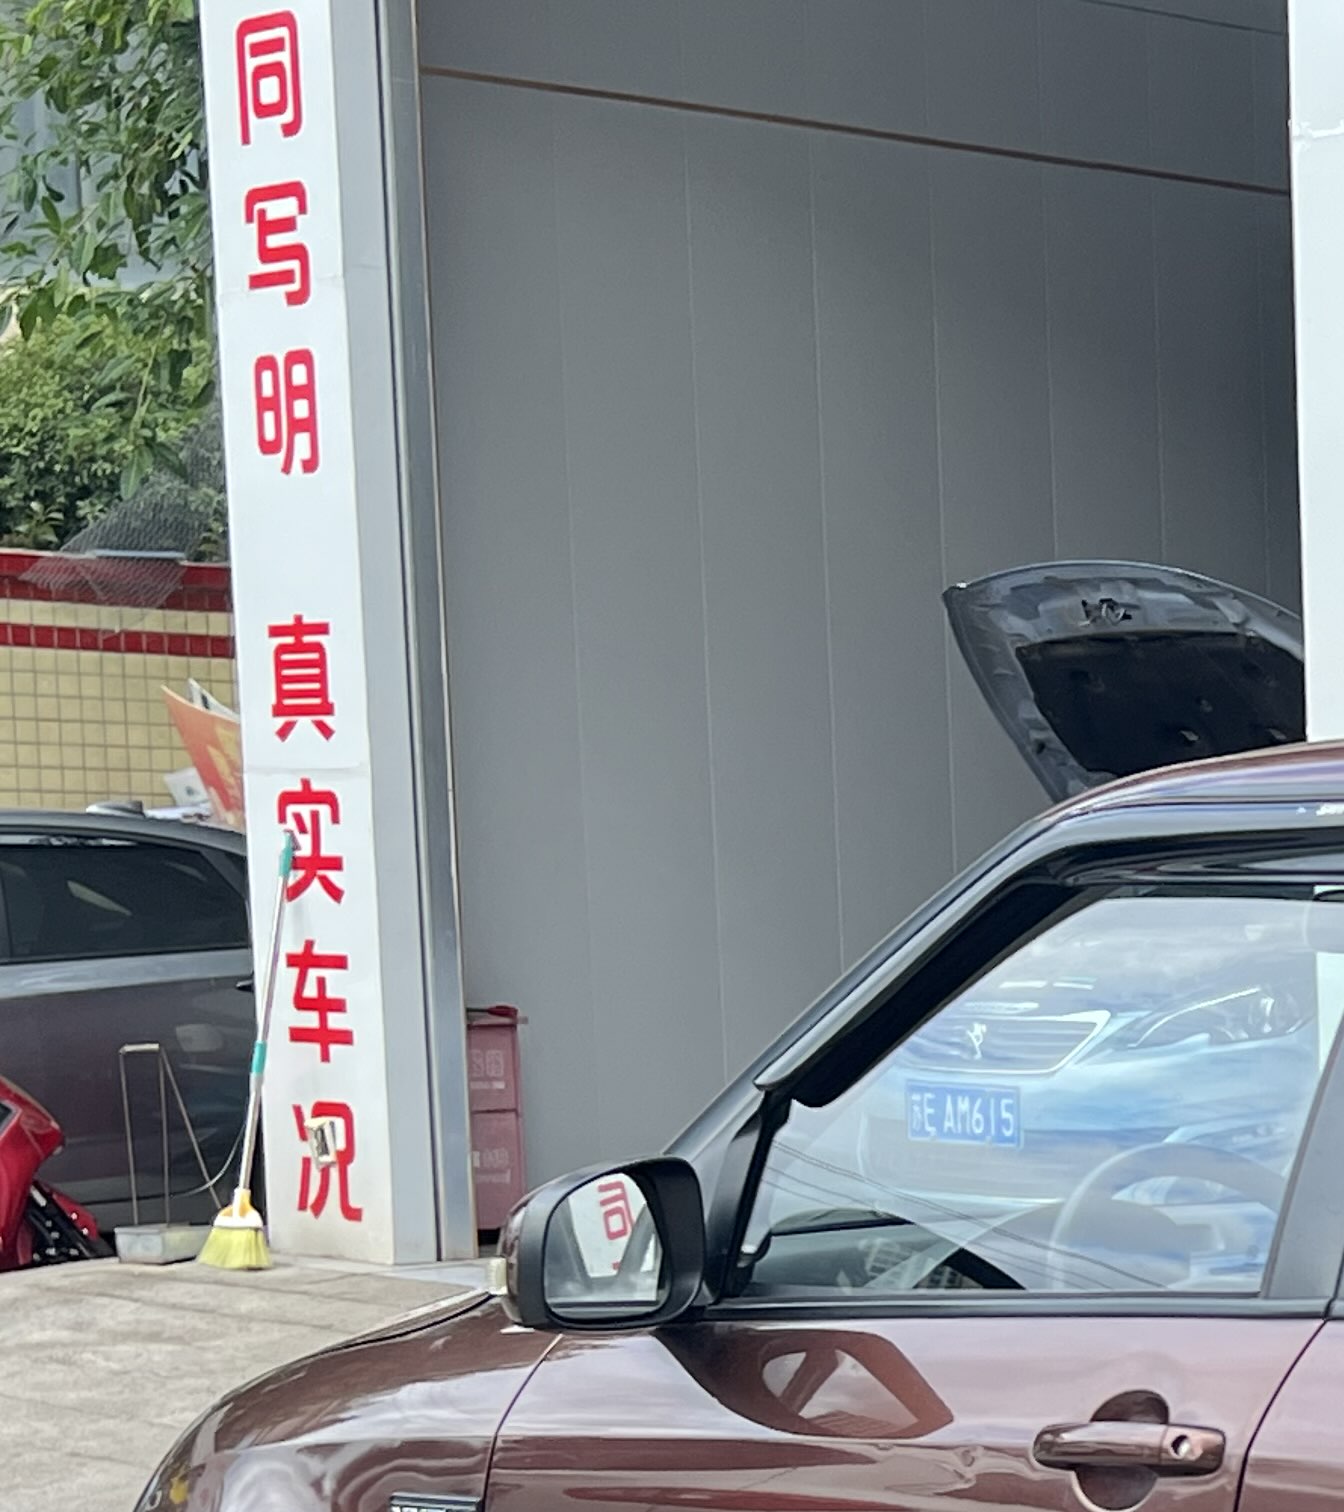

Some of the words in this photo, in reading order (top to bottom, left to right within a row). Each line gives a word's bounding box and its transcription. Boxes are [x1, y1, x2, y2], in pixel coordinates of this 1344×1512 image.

[236, 11, 319, 474] 同写明
[267, 614, 363, 1223] 真实车况
